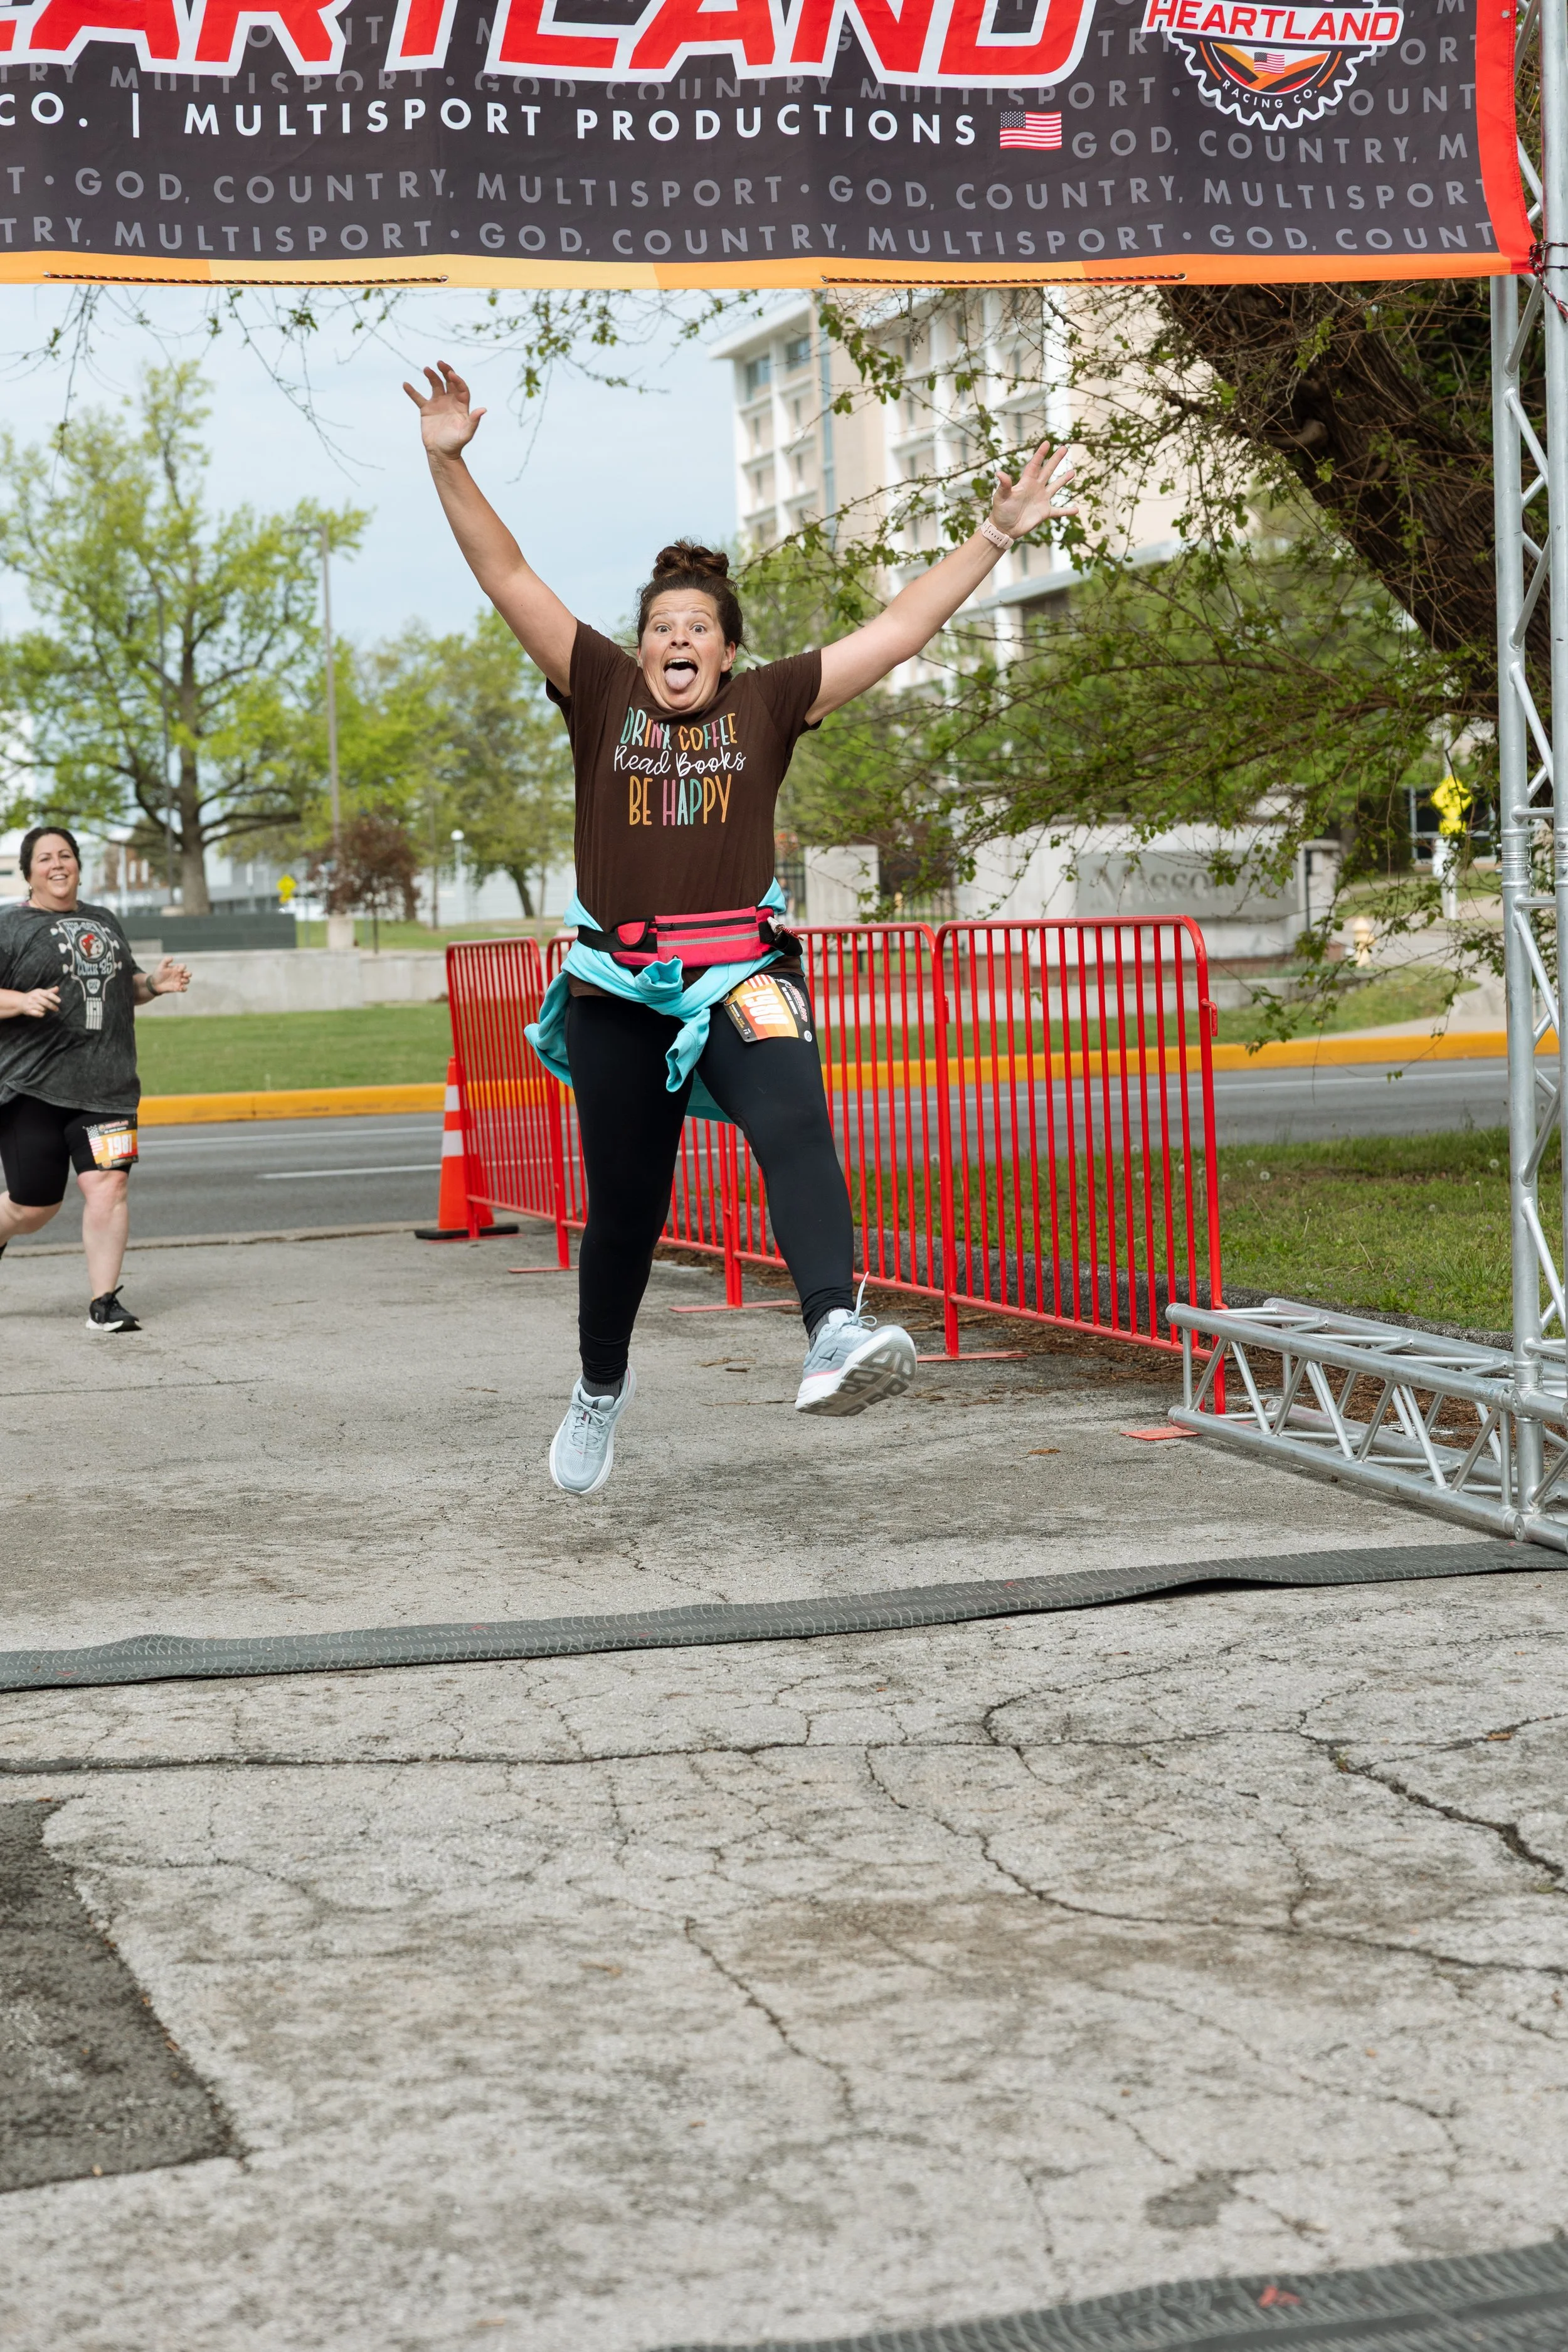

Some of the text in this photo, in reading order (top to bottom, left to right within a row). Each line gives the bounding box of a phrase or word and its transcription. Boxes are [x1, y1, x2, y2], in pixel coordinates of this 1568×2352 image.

[1147, 0, 1399, 41] HEARTLAND
[0, 0, 1095, 88] ARLAND
[1222, 80, 1283, 108] RACING
[1293, 90, 1318, 105] CO.
[0, 91, 88, 127] CO.
[184, 98, 541, 136] MULTISPORT
[576, 103, 976, 146] PRODUCTIONS
[1072, 126, 1179, 159] GOD,
[1199, 129, 1417, 164] COUNTRY,
[75, 167, 190, 204] GOD,
[213, 168, 454, 204] COUNTRY,
[477, 172, 782, 208] MULTISPORT
[829, 175, 935, 211] GOD,
[955, 175, 1184, 210] COUNTRY,
[114, 220, 432, 253] MULTISPORT
[479, 222, 590, 255] GOD,
[612, 223, 847, 256] COUNTRY,
[868, 224, 1165, 255] MULTISPORT
[1209, 224, 1318, 252] GOD,
[1335, 221, 1493, 250] COUNT
[620, 706, 738, 751] DRINK COFFEE
[613, 744, 746, 777] Read Books
[629, 773, 732, 826] BE HAPPY
[741, 988, 790, 1025] 1980
[107, 1133, 132, 1157] 1981
